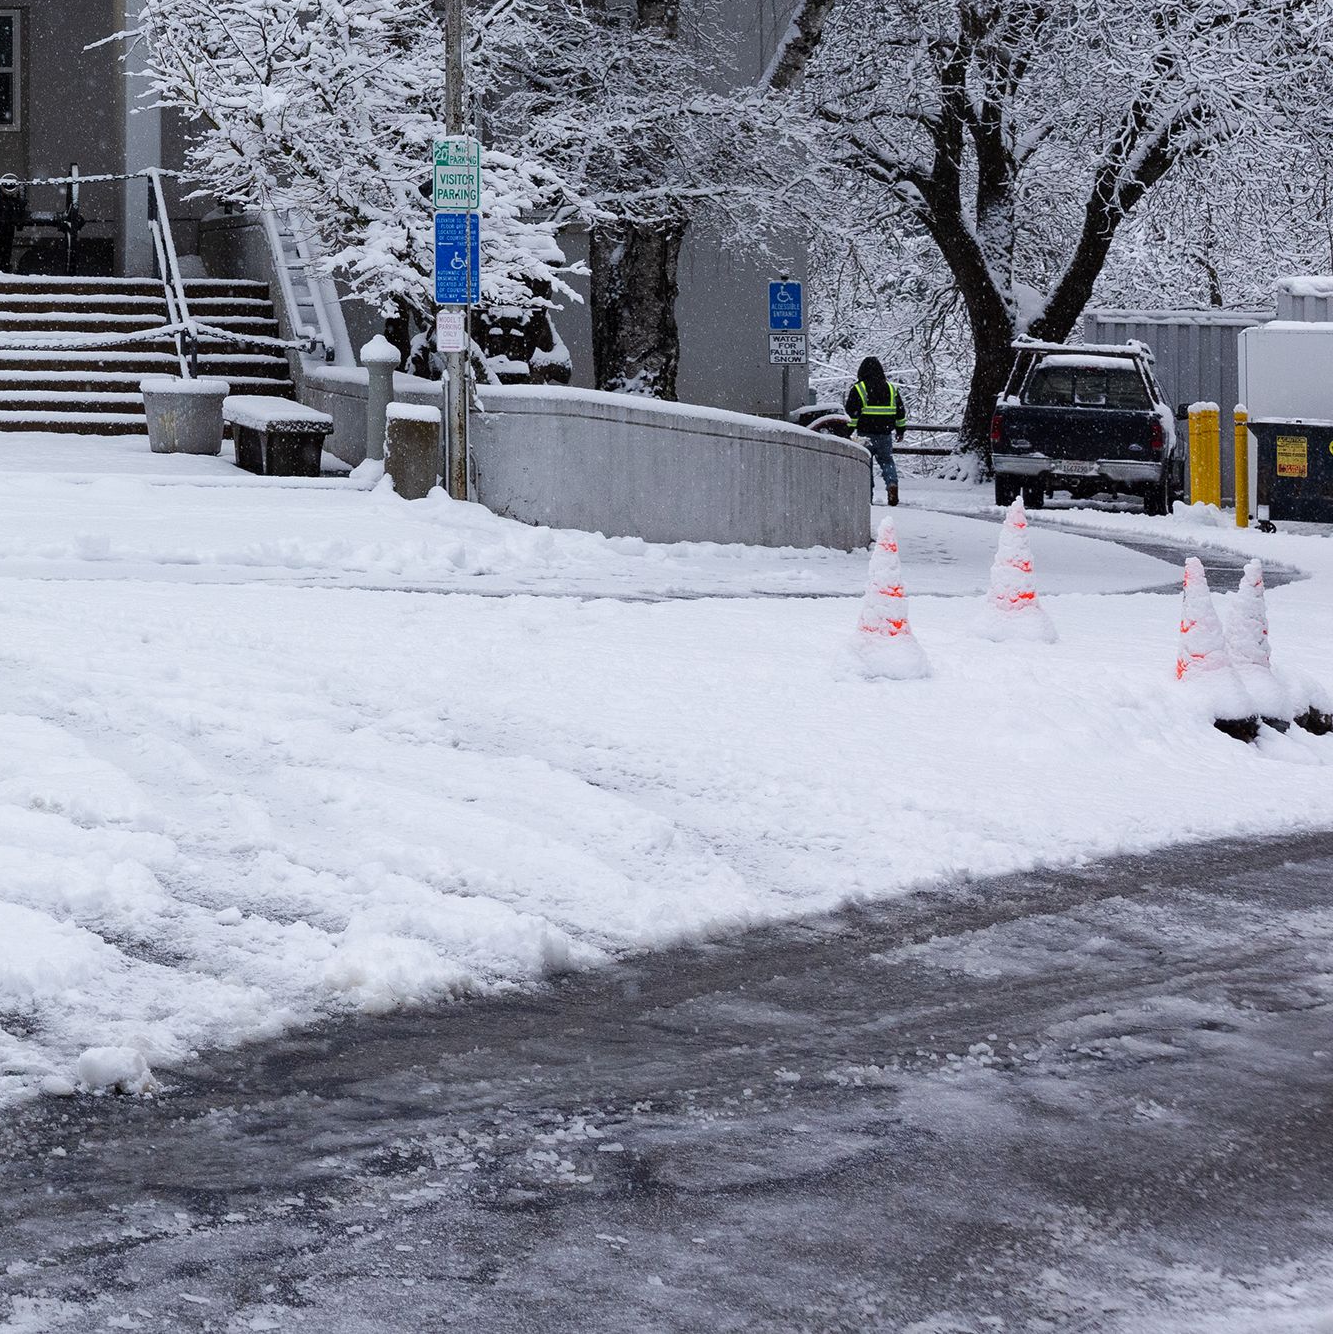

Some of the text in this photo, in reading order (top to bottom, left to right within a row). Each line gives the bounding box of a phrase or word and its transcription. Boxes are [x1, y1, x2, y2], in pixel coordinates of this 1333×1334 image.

[435, 149, 447, 159] 20
[450, 155, 477, 165] PARKNG
[440, 173, 475, 185] VISITOR
[437, 188, 476, 200] PARKING
[770, 303, 800, 311] ACCESSIBLE
[773, 310, 798, 318] ENTRANCE
[438, 323, 462, 331] PARKING
[772, 335, 803, 343] WATCH
